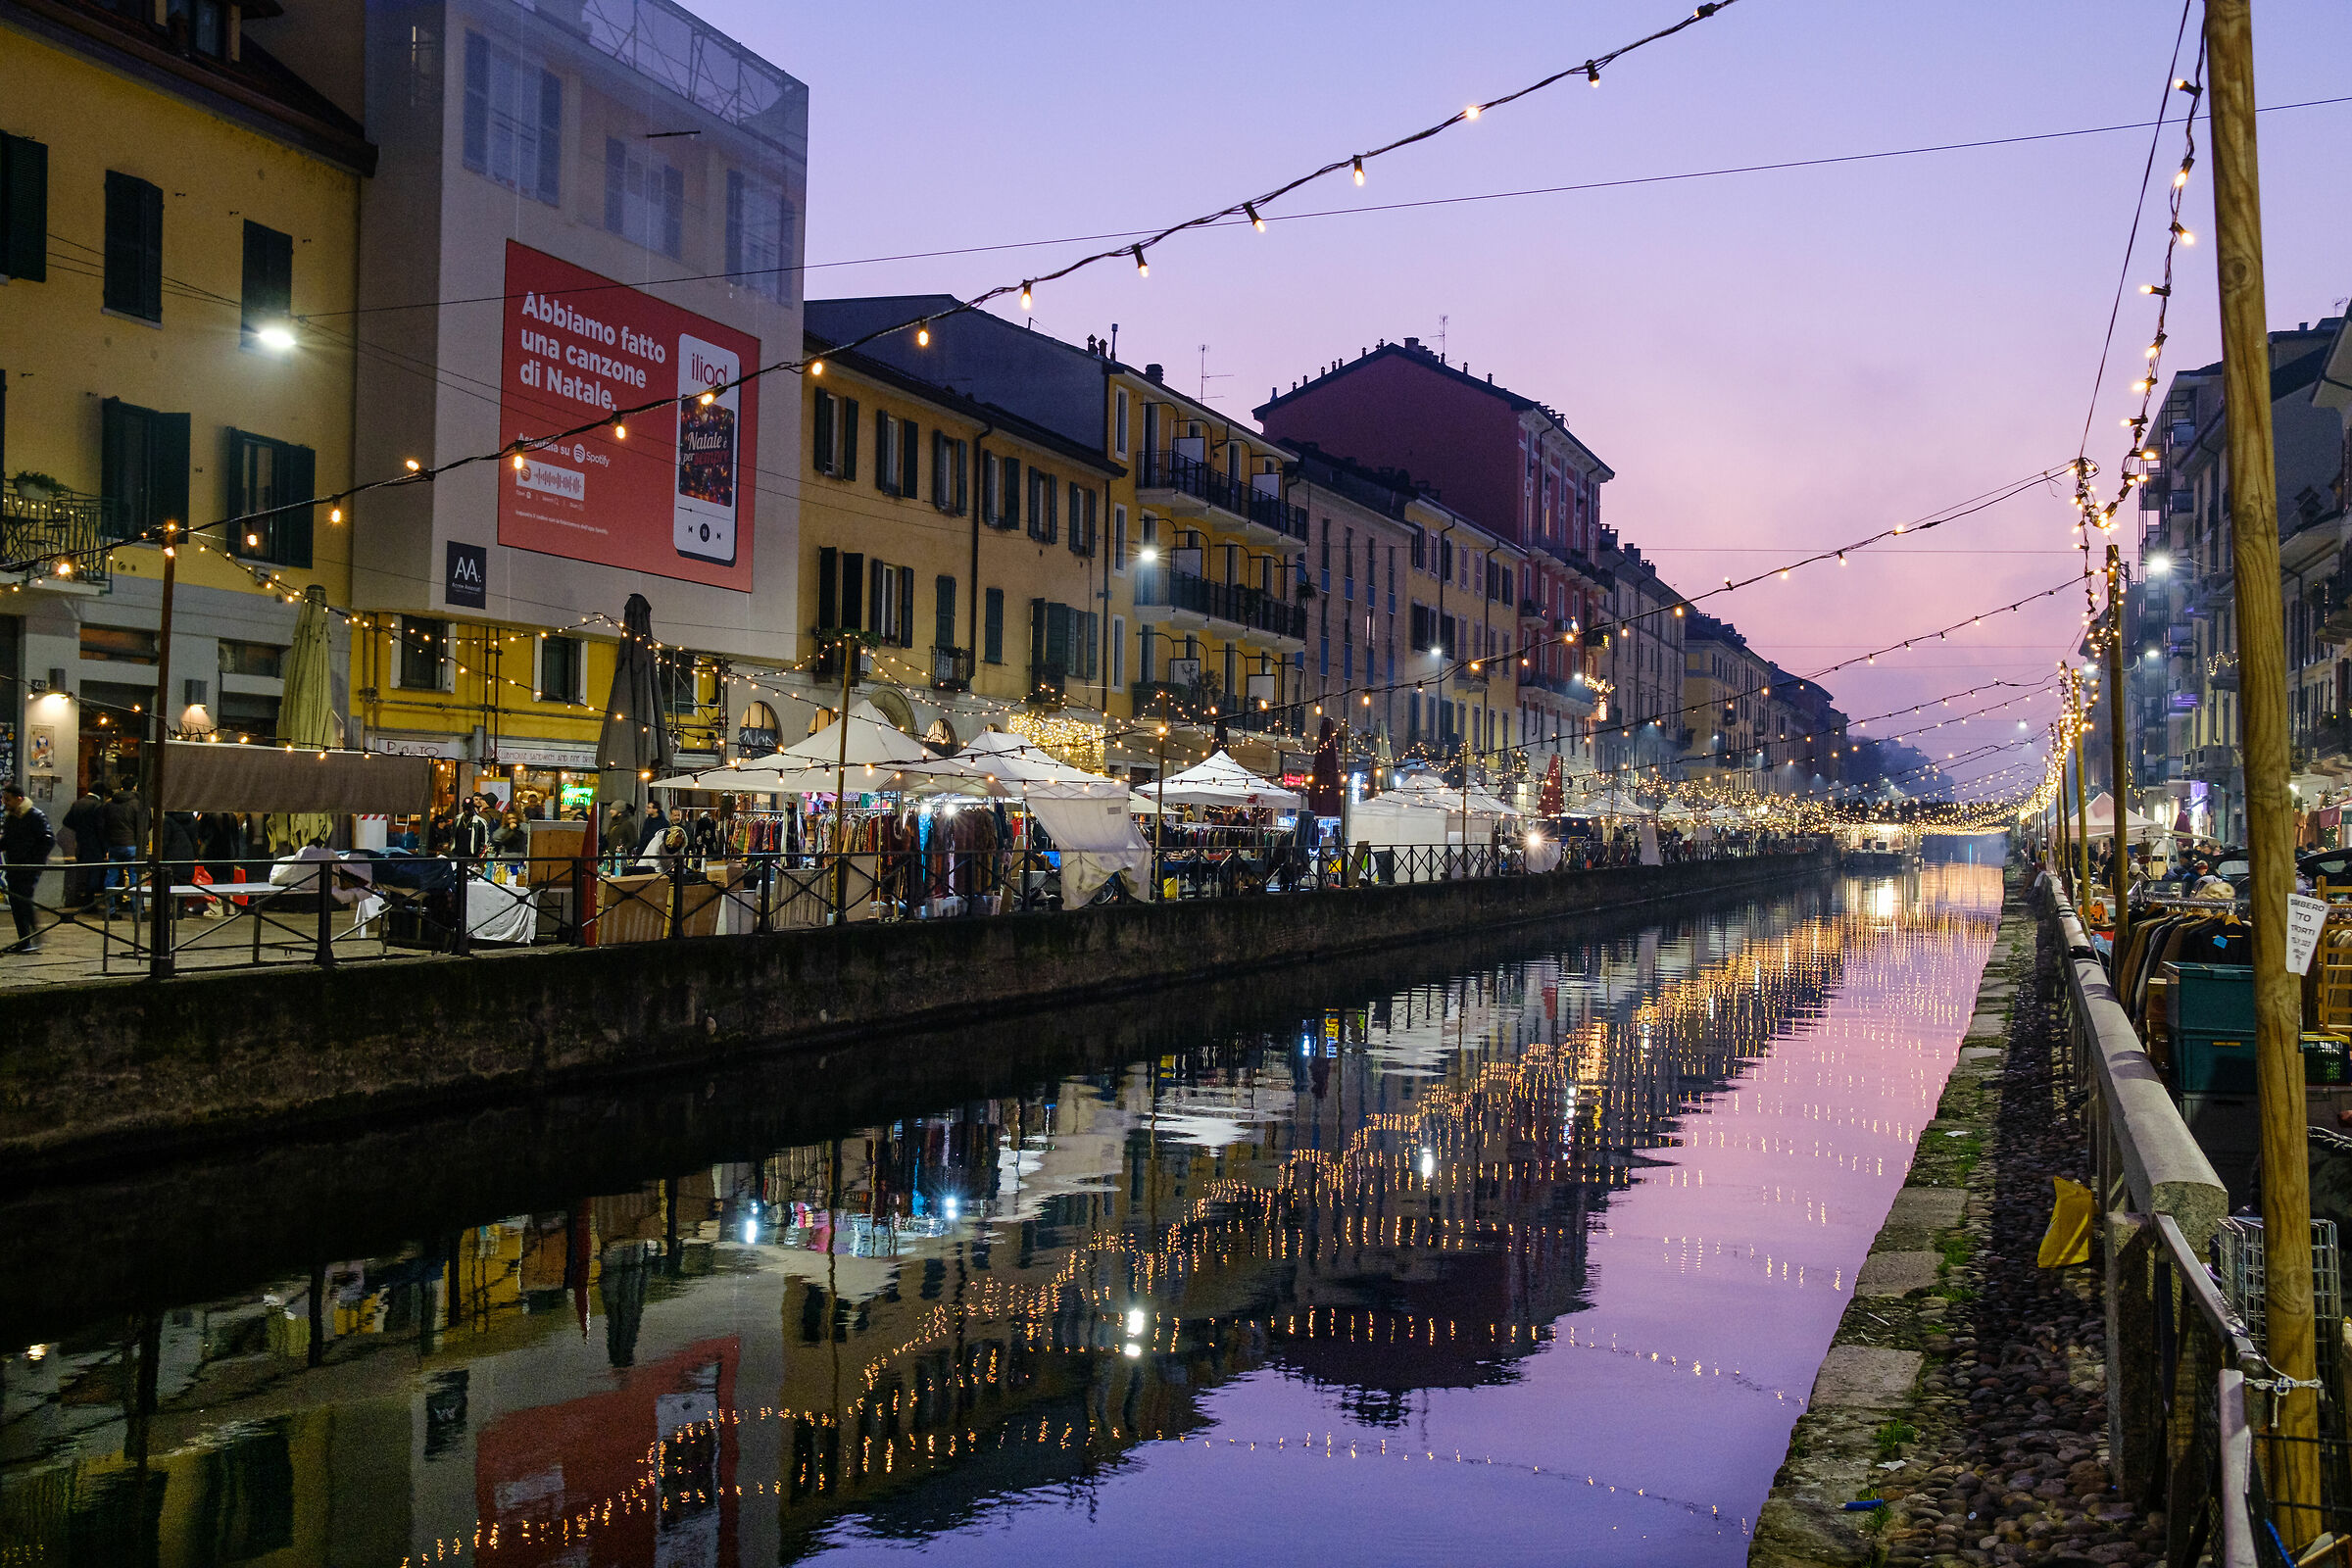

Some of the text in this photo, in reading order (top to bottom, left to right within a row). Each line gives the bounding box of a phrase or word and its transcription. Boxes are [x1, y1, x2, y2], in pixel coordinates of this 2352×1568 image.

[521, 291, 666, 364] Abbiamo fatto
[521, 329, 647, 389] una canzone
[691, 353, 728, 386] iliad
[520, 360, 617, 412] di Natale.
[560, 445, 570, 457] su
[586, 451, 611, 467] Spotify
[687, 431, 723, 451] Natale
[682, 453, 695, 466] per
